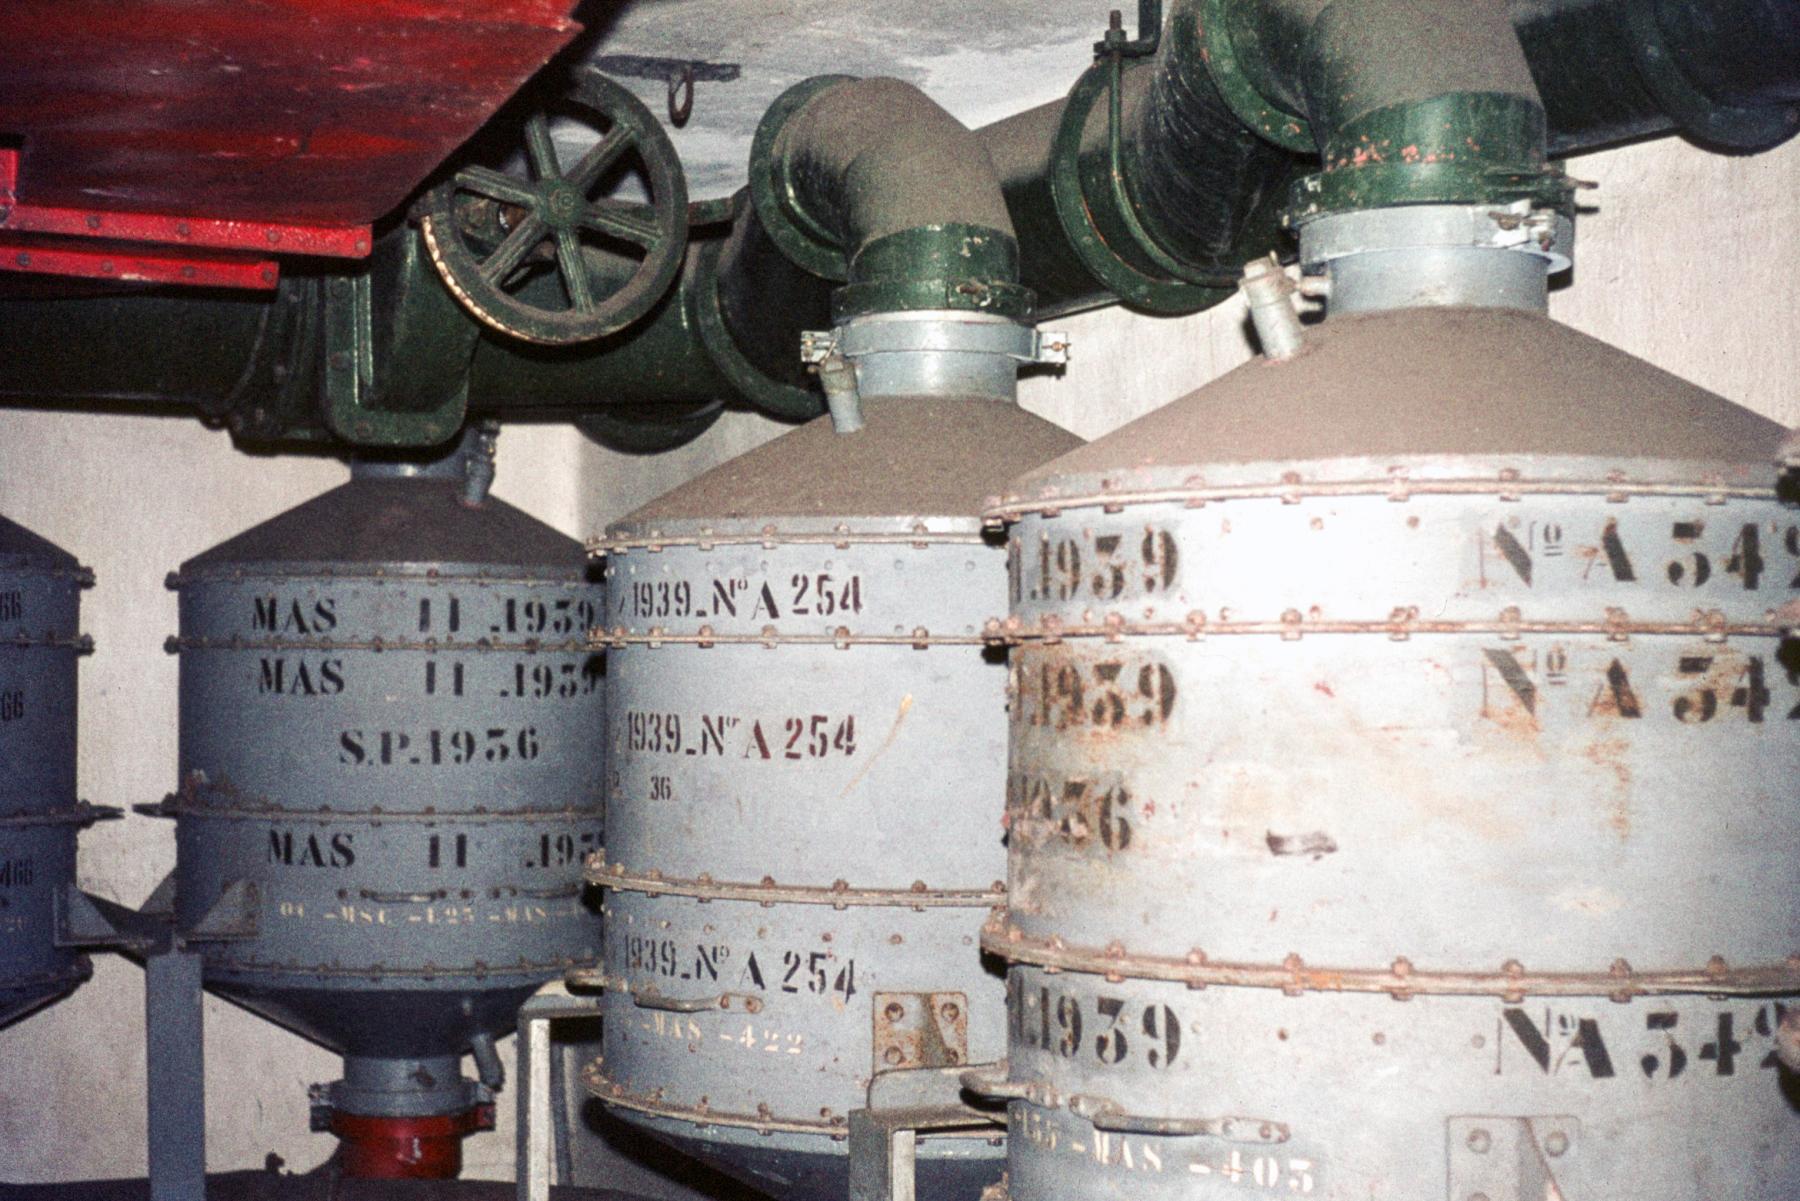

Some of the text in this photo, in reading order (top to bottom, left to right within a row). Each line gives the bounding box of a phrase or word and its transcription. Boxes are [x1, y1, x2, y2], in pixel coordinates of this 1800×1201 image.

[252, 598, 338, 633] MAS
[751, 579, 780, 620] A
[790, 573, 863, 616] 254
[258, 658, 346, 696] MAS
[741, 718, 771, 760] A
[784, 714, 857, 760] 254
[267, 829, 356, 868] MAS
[739, 950, 766, 990] A
[781, 950, 857, 1004] 254
